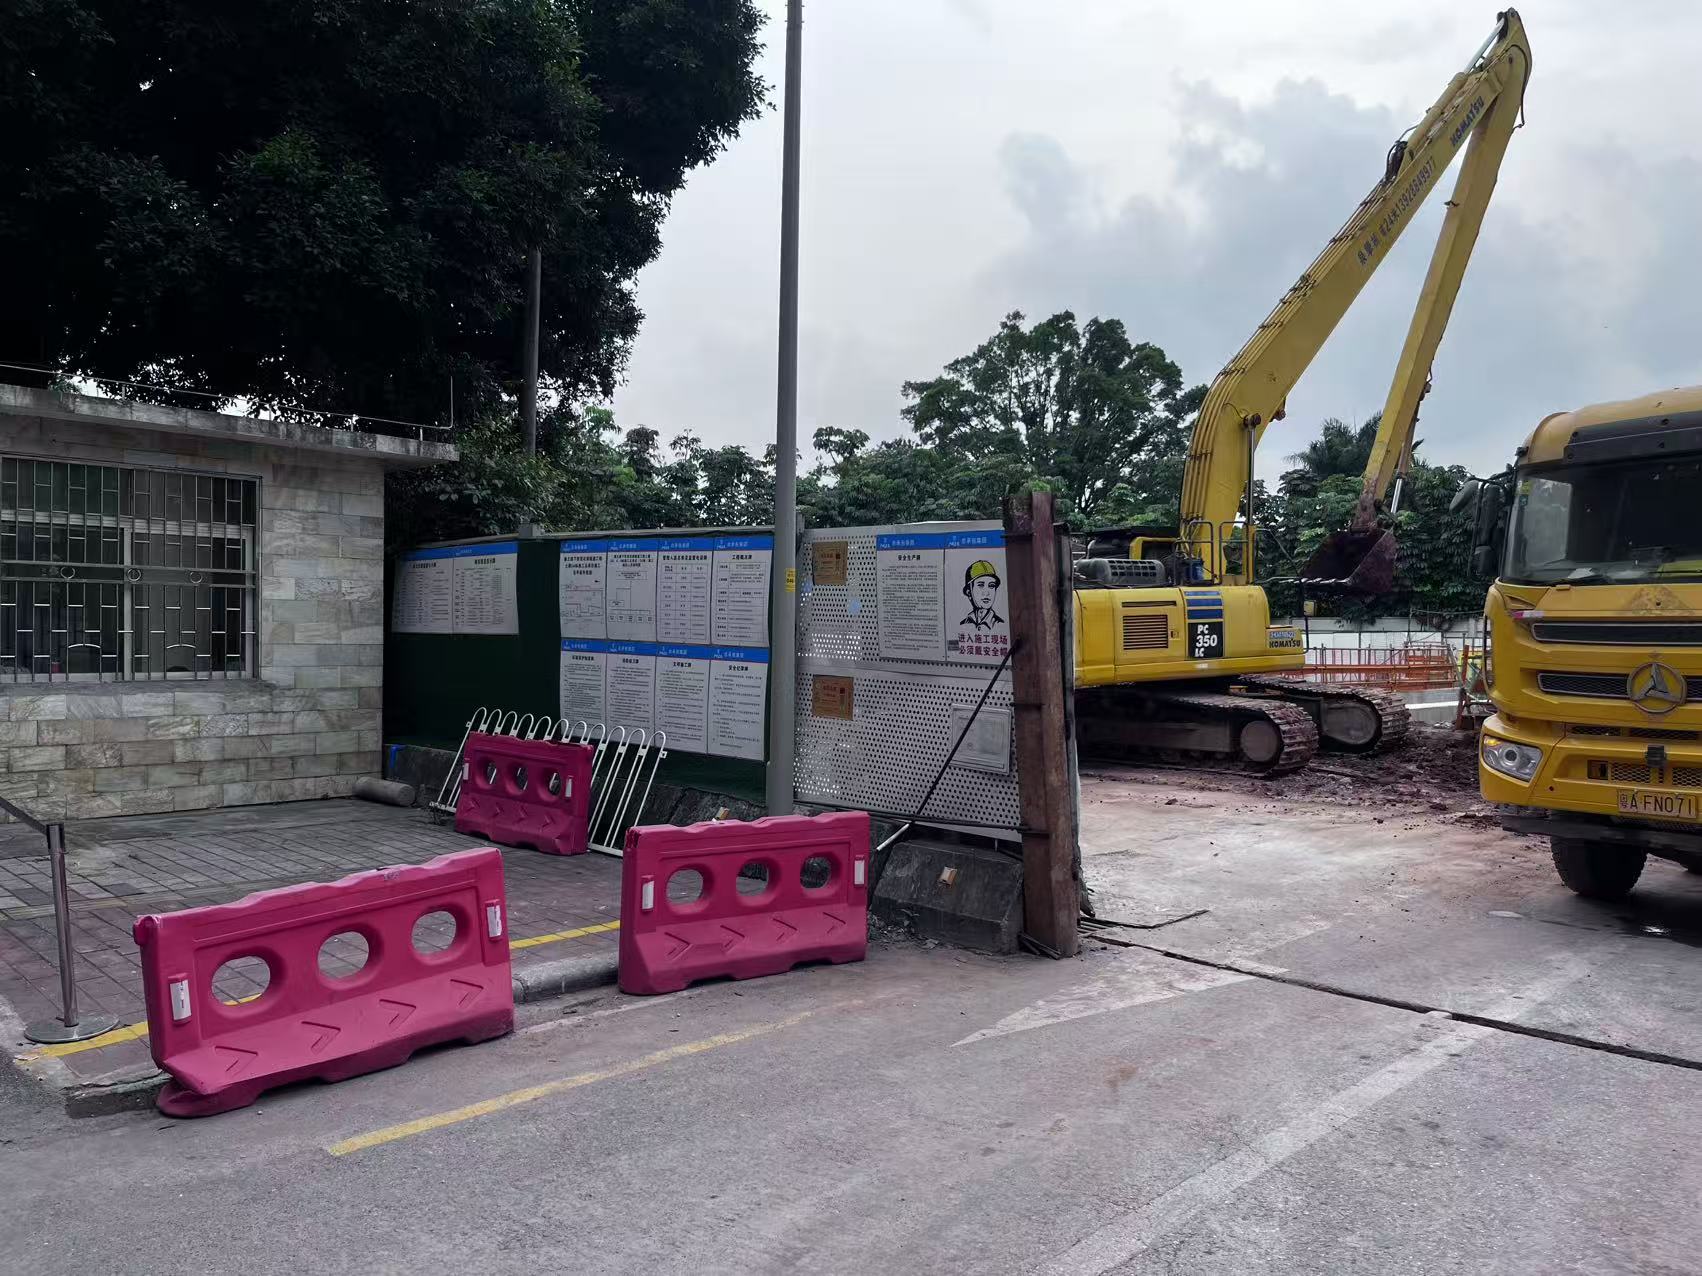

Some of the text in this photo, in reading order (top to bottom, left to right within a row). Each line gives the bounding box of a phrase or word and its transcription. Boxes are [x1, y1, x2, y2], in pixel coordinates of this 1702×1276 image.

[1450, 96, 1485, 146] KOMATSU
[1197, 624, 1209, 634] PC
[958, 633, 1008, 645] 进入施工现场
[1195, 634, 1218, 648] 350
[1269, 638, 1301, 648] KOMATSU
[958, 645, 1008, 657] 必须戴安全帽
[1194, 647, 1205, 657] LC
